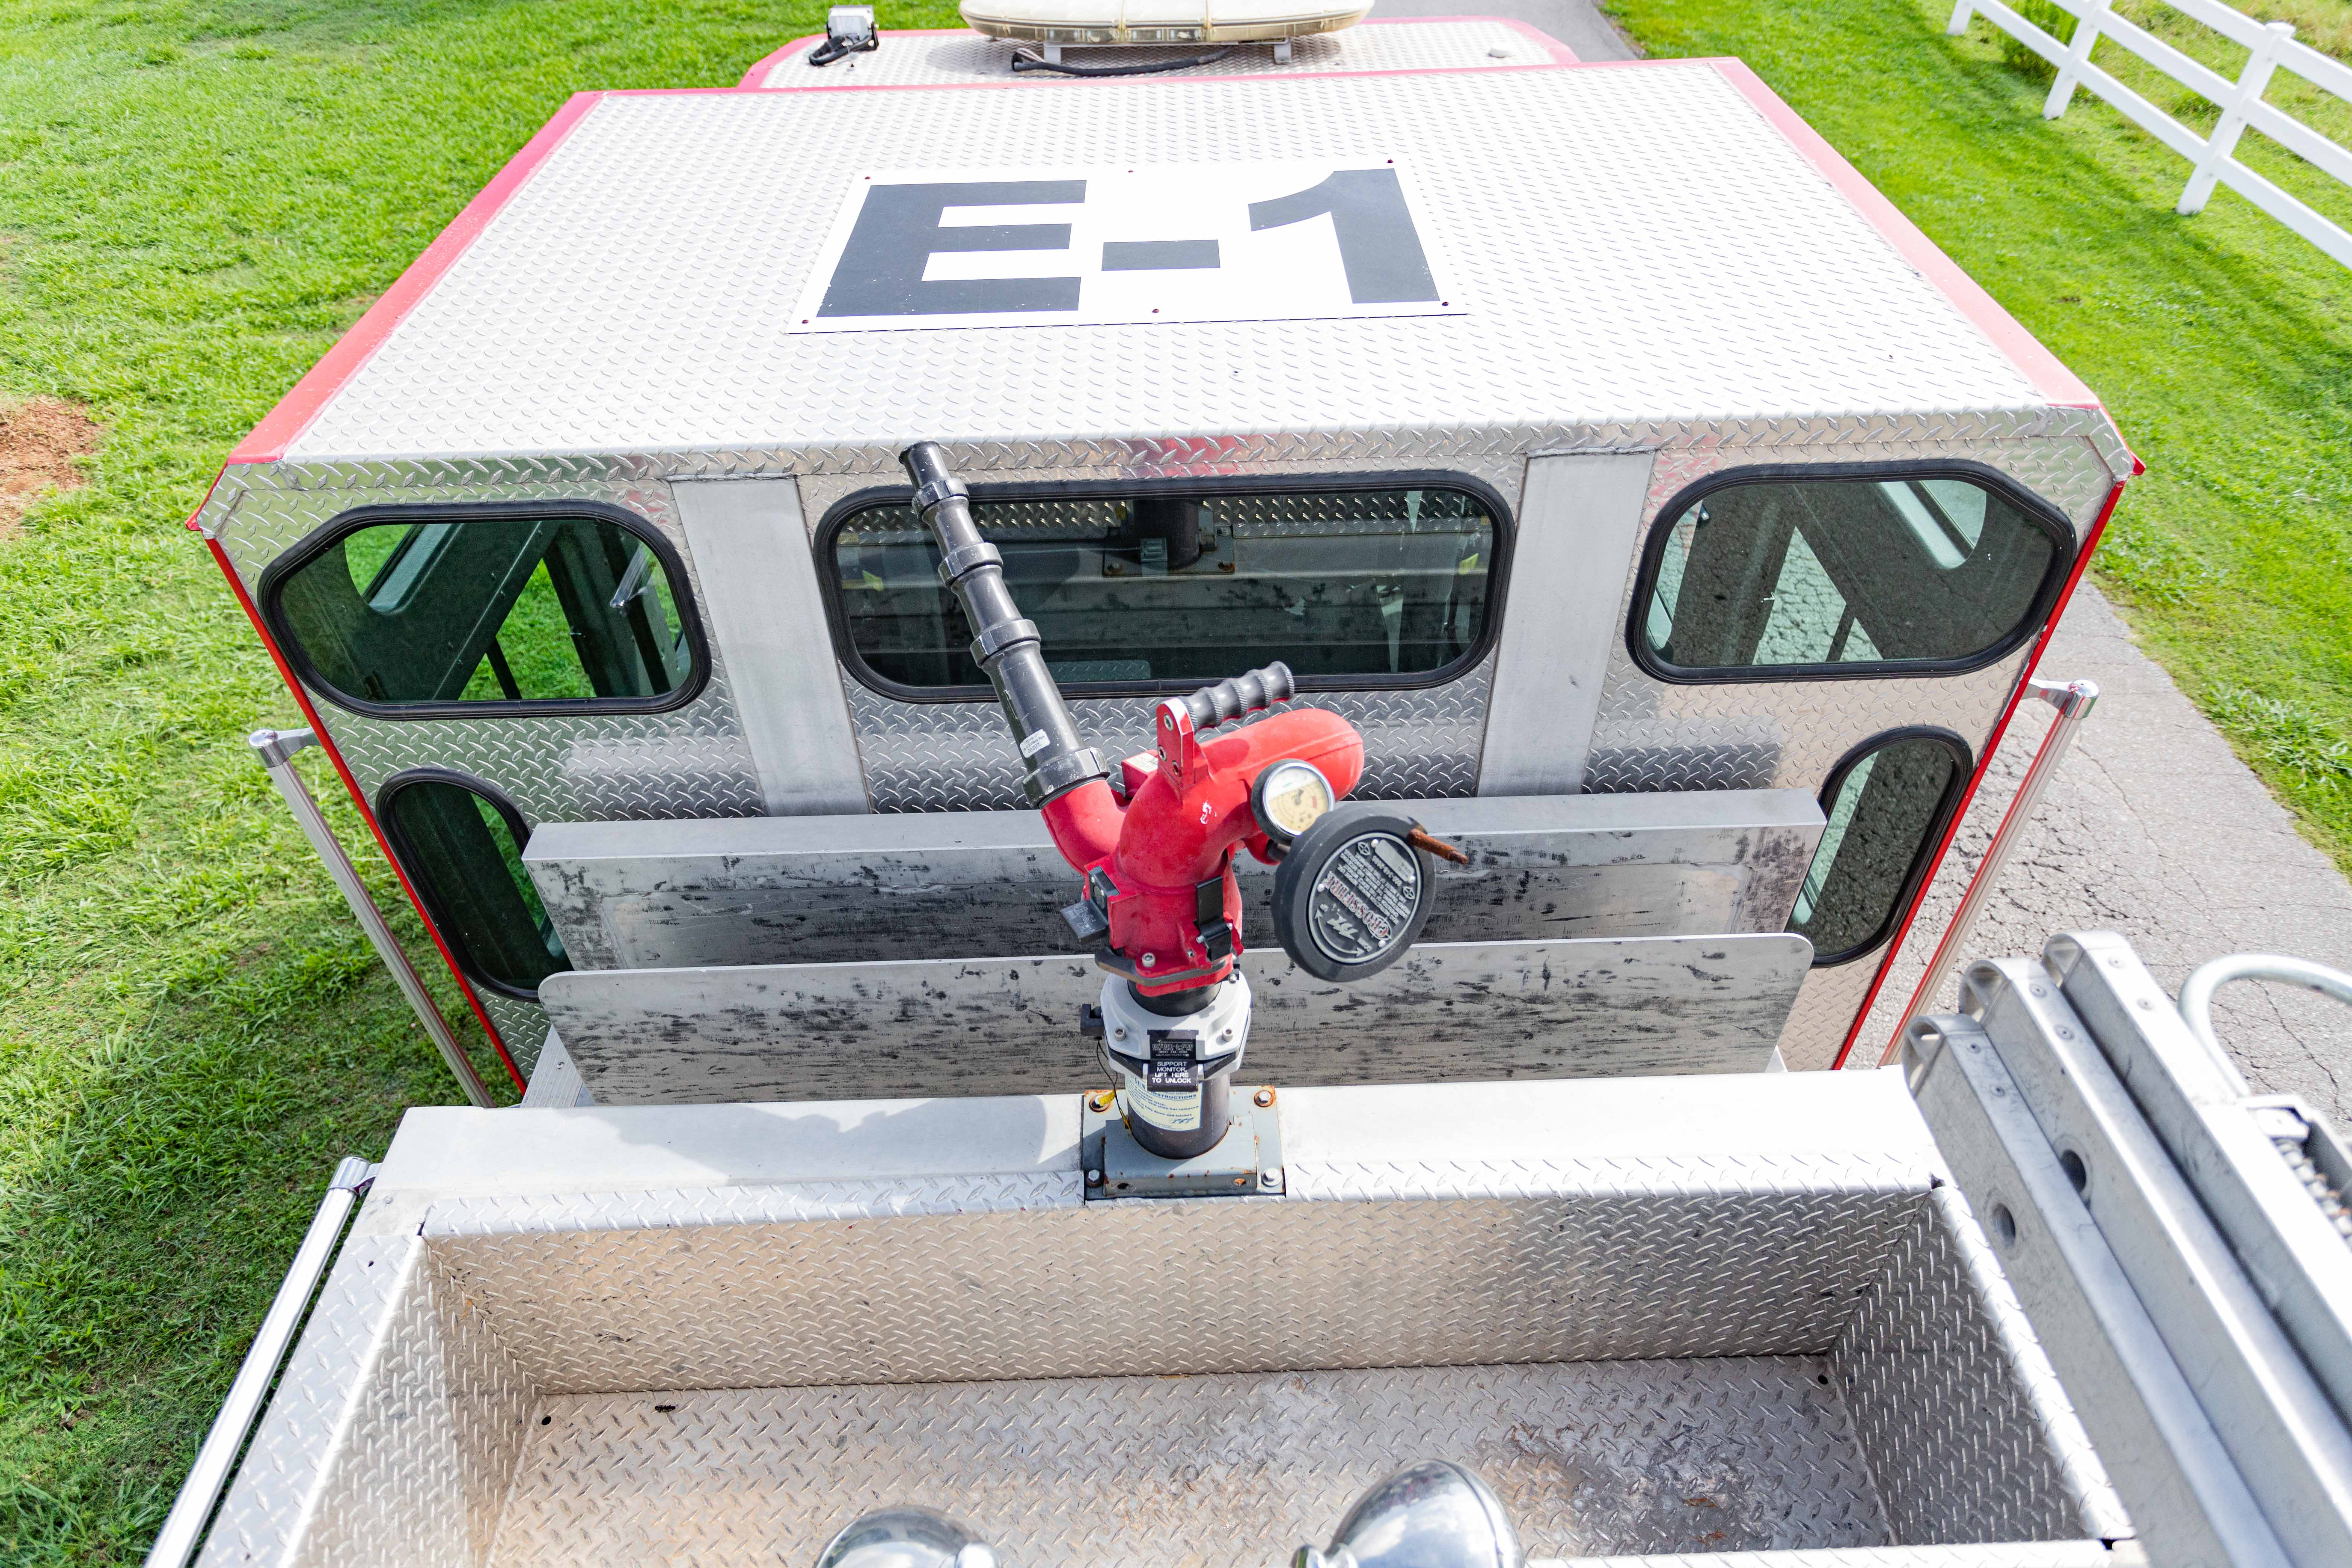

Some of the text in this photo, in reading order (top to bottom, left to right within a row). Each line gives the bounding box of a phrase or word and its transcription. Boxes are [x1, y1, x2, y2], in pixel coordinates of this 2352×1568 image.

[816, 168, 1441, 317] E-1
[1320, 870, 1391, 941] CROSSFIRE
[1320, 903, 1329, 912] UP
